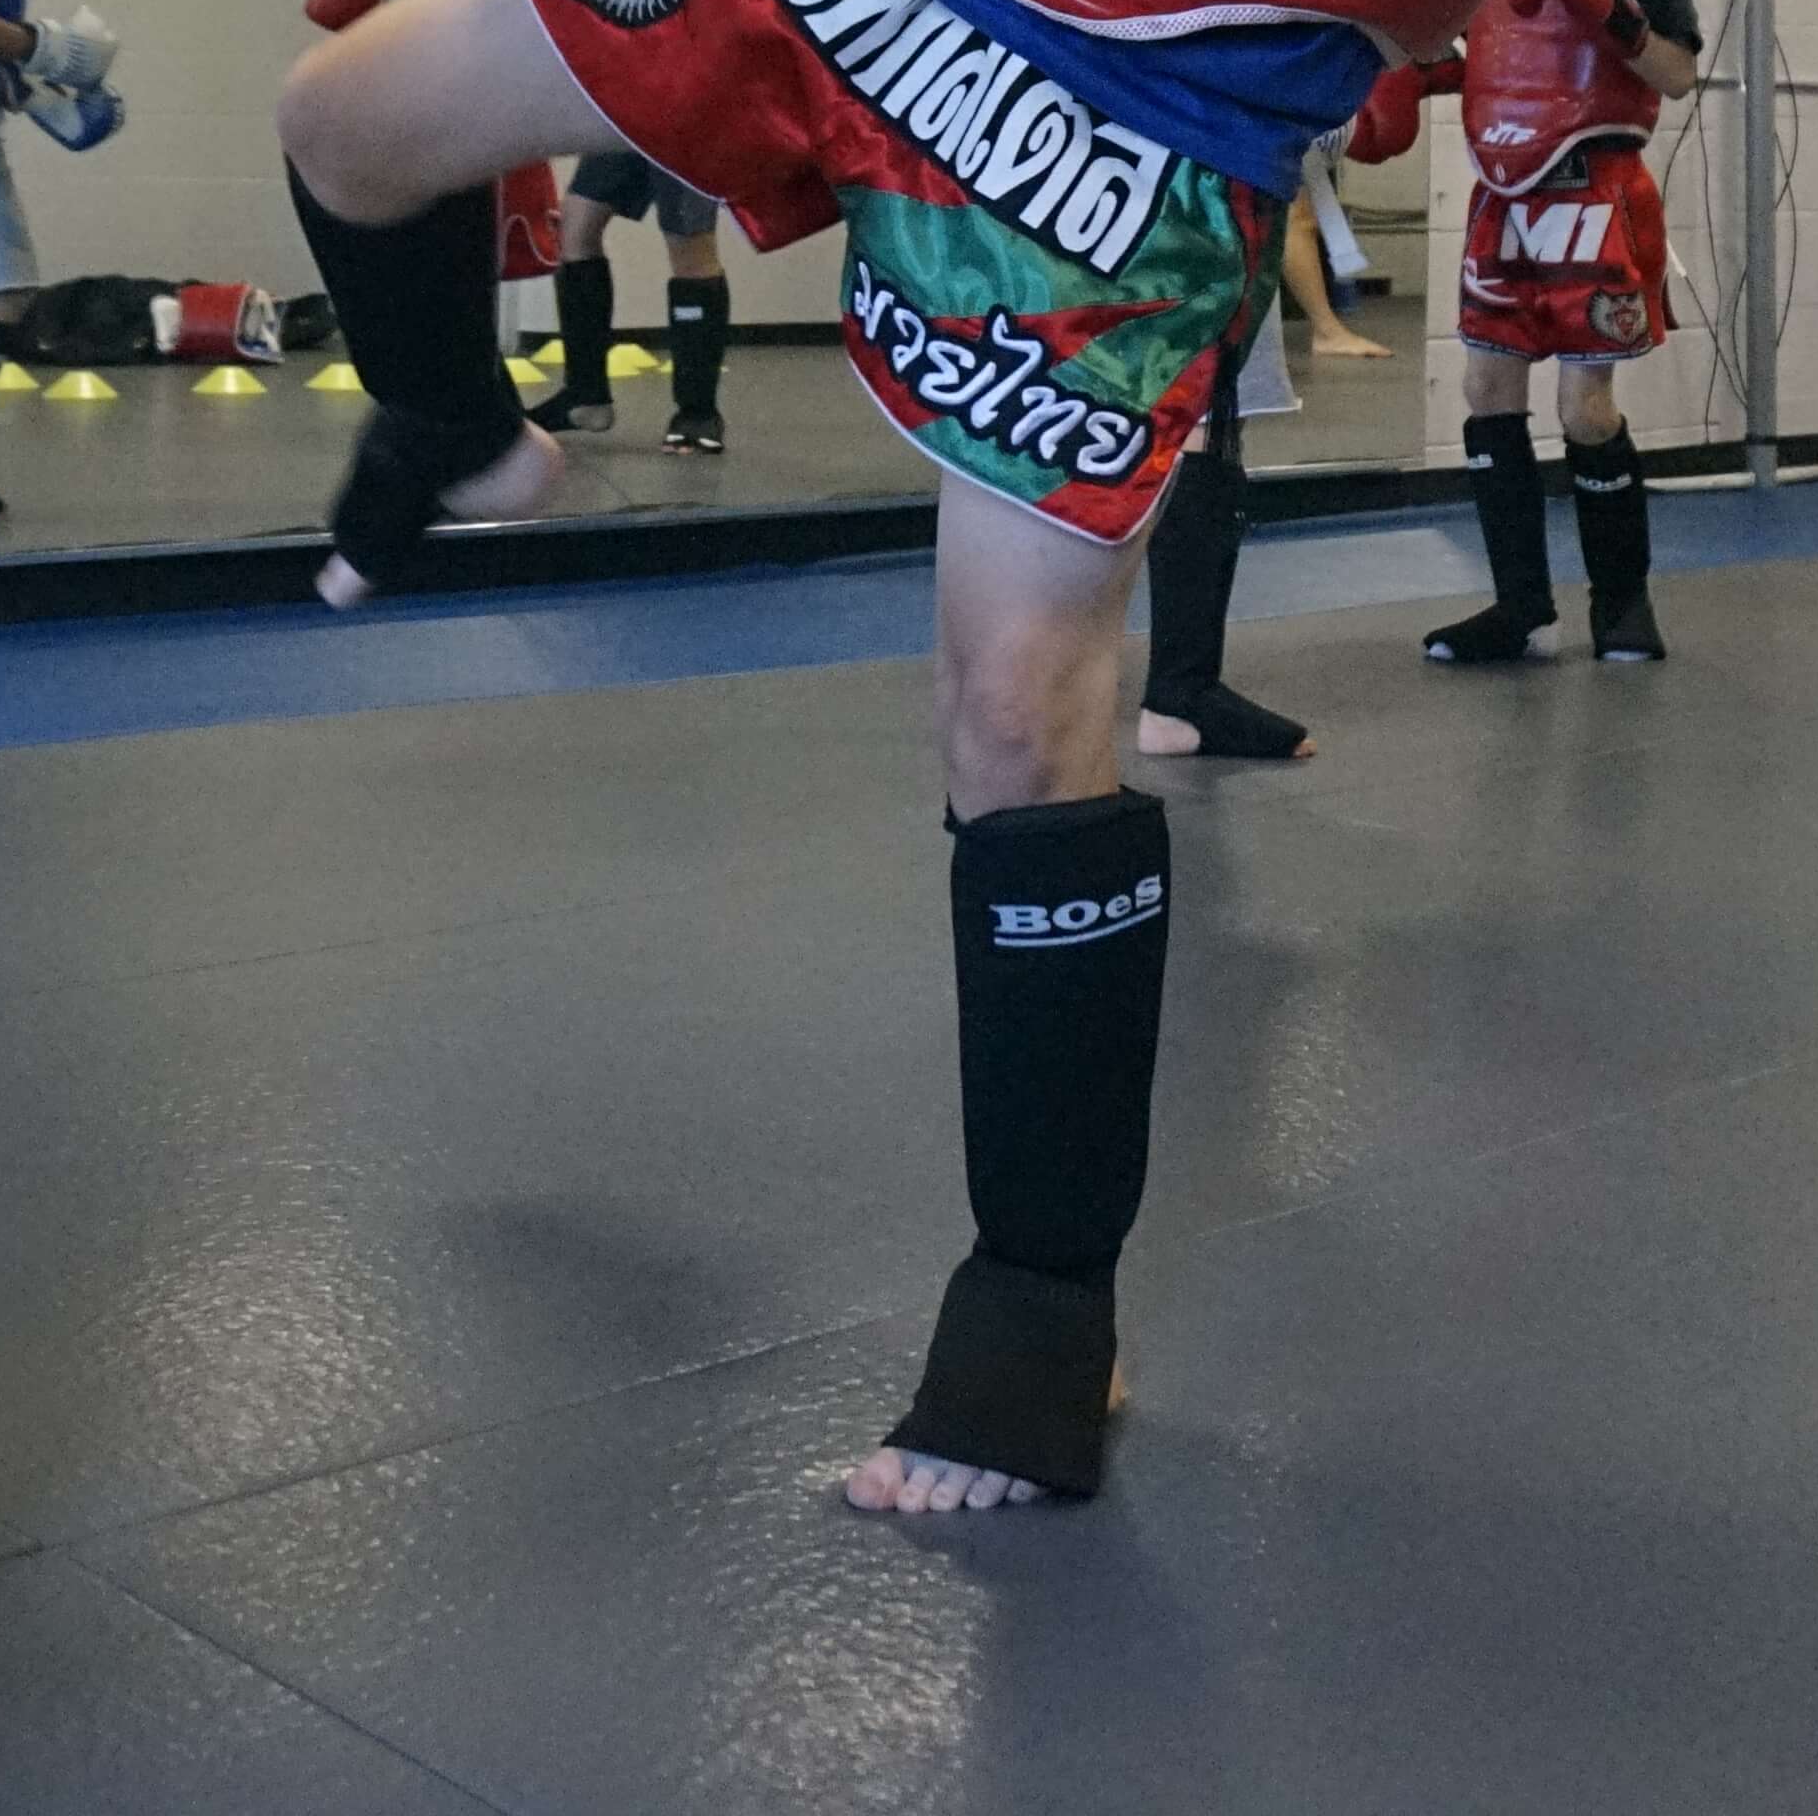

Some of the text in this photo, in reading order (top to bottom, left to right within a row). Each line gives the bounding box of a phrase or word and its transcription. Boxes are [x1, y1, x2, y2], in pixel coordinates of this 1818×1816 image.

[1500, 202, 1615, 263] M1
[855, 262, 1147, 477] มวยไทย
